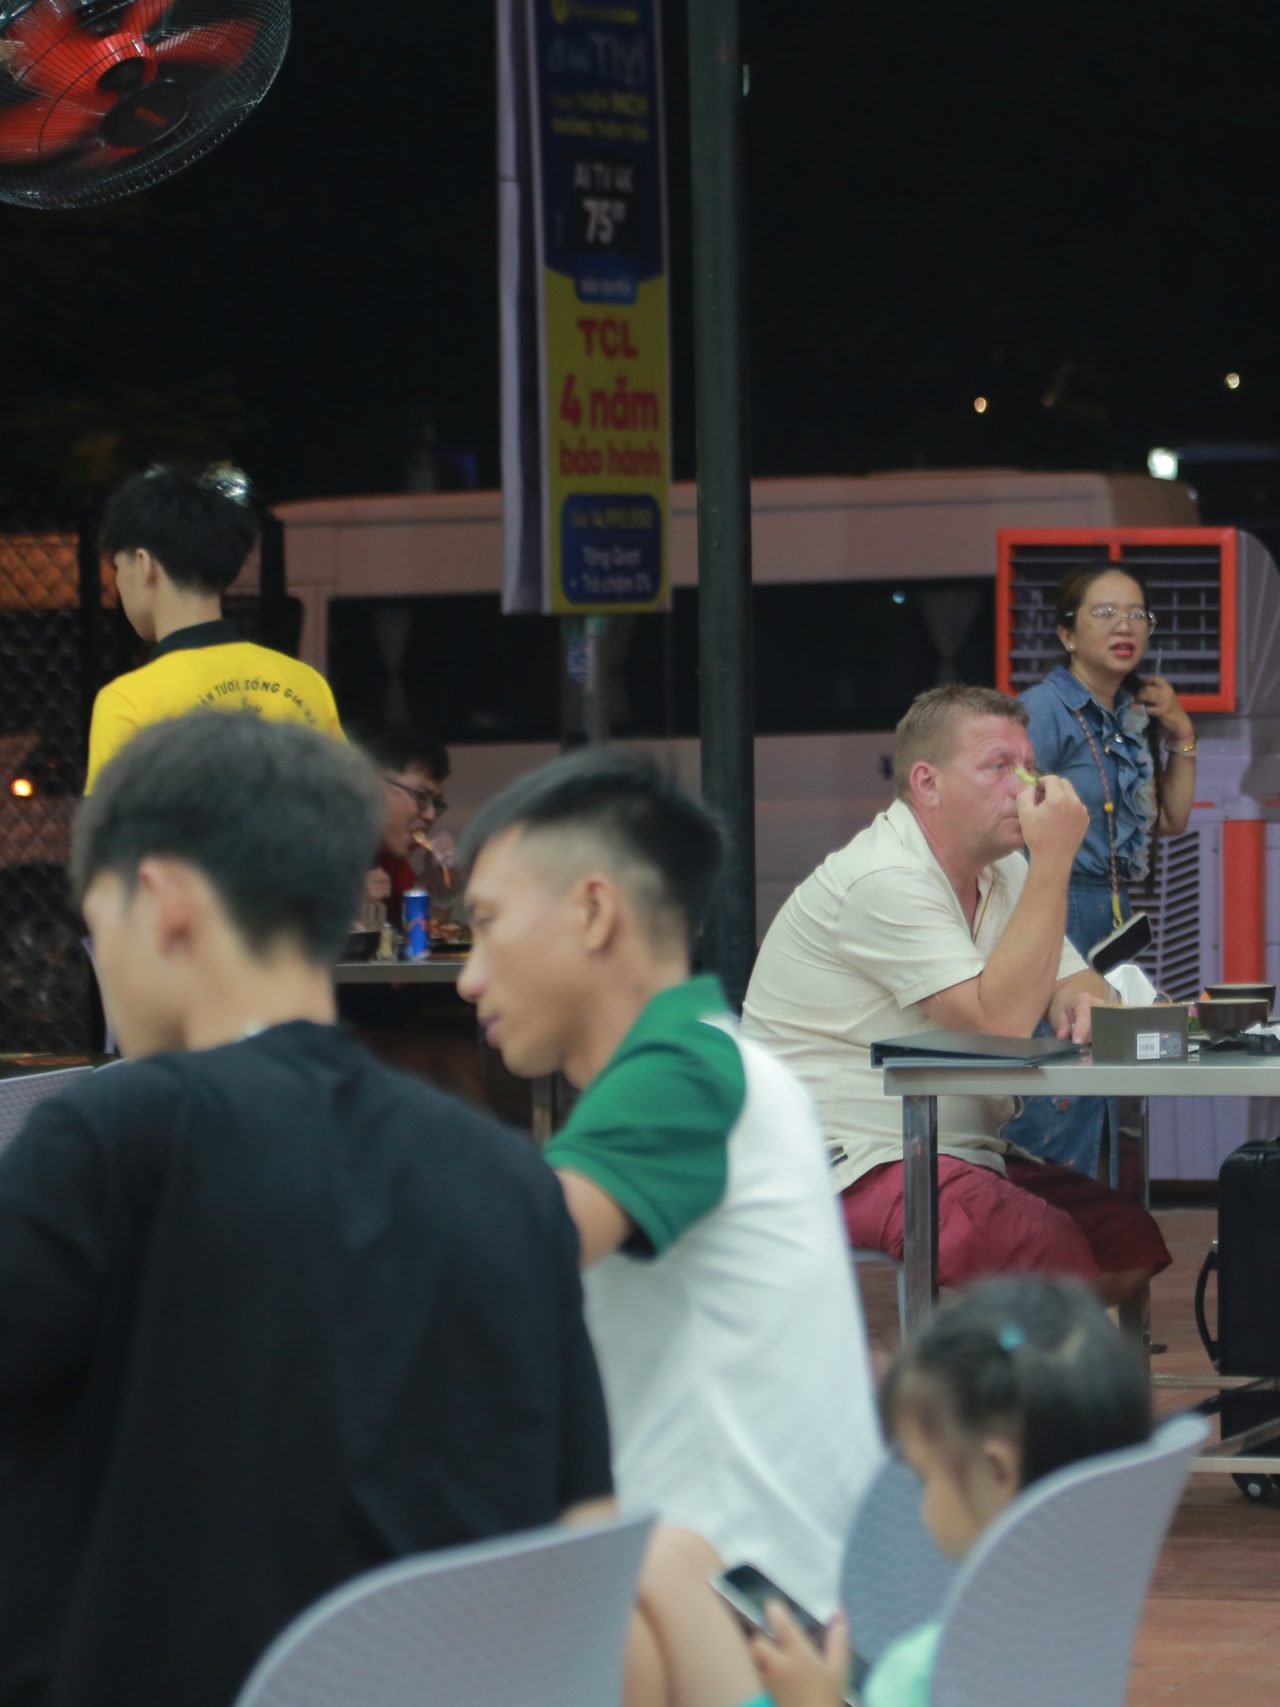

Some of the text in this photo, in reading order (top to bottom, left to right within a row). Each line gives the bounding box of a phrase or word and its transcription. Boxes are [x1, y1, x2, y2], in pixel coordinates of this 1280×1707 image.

[576, 317, 639, 359] TCL
[560, 373, 660, 432] 4 năm
[559, 436, 663, 479] bảo hành
